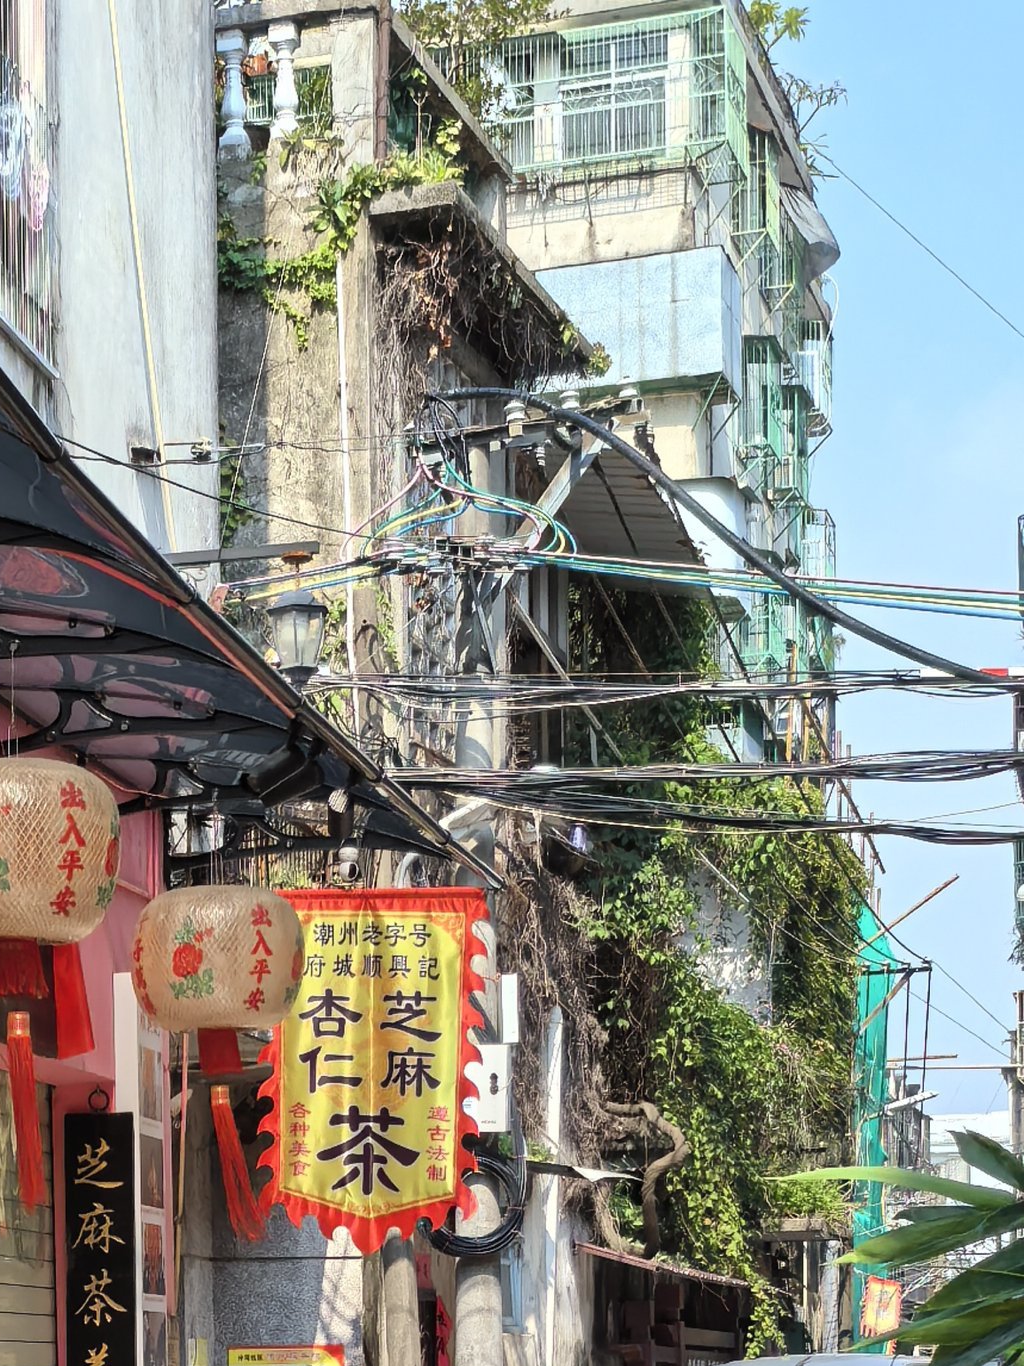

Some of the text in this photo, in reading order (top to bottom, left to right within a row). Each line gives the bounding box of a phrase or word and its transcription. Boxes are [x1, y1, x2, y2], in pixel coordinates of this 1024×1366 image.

[50, 781, 88, 918] 出入平安
[244, 904, 274, 1012] 出入平安
[313, 922, 431, 947] 潮州老字号
[298, 988, 363, 1094] 杏仁
[379, 990, 442, 1098] 芝麻
[288, 1102, 311, 1176] 各种美食
[316, 1105, 421, 1195] 茶
[426, 1105, 451, 1182] 遵古法制
